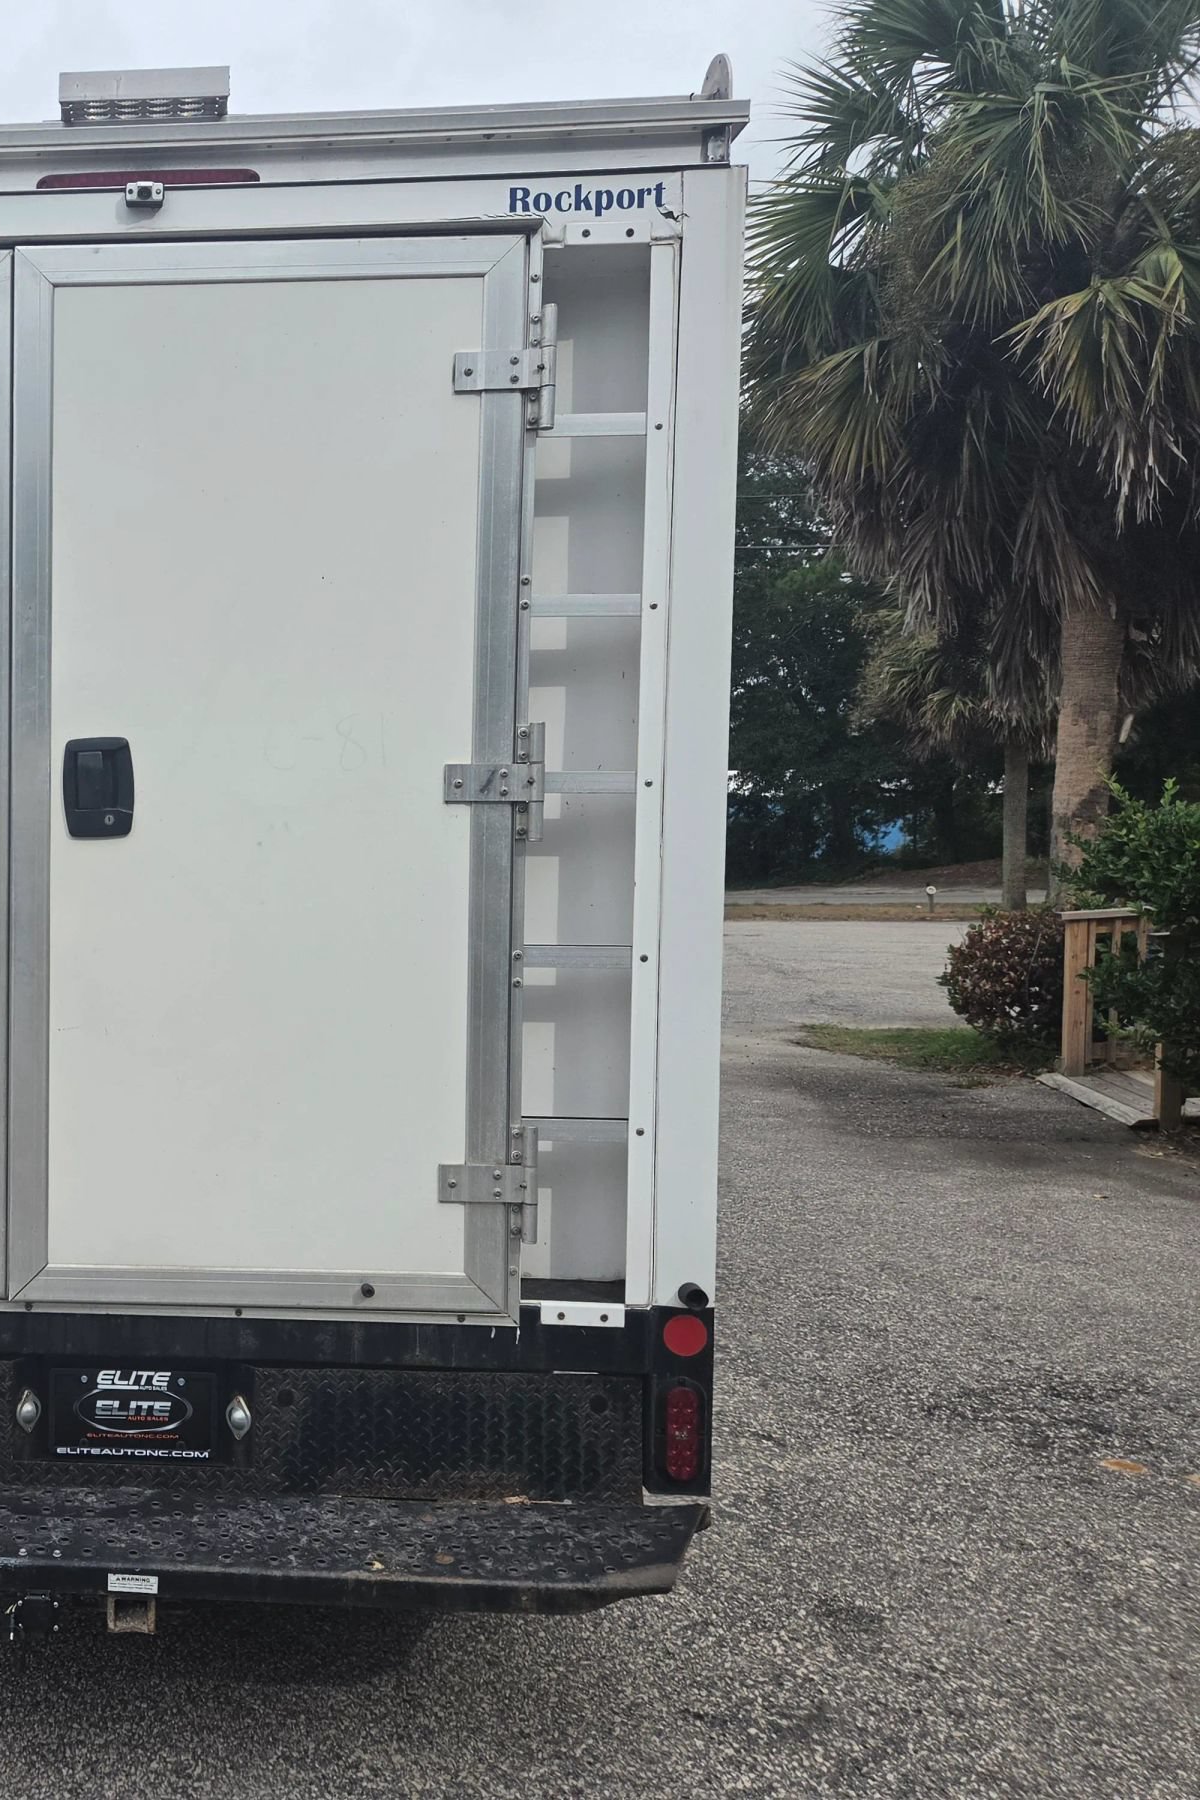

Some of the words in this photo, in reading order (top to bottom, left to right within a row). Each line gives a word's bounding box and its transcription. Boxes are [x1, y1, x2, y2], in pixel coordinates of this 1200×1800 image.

[509, 182, 666, 217] Rockport
[97, 1370, 171, 1386] ELITE
[96, 1400, 171, 1416] ELITE
[56, 1447, 209, 1458] ELITEAUTONC.COM
